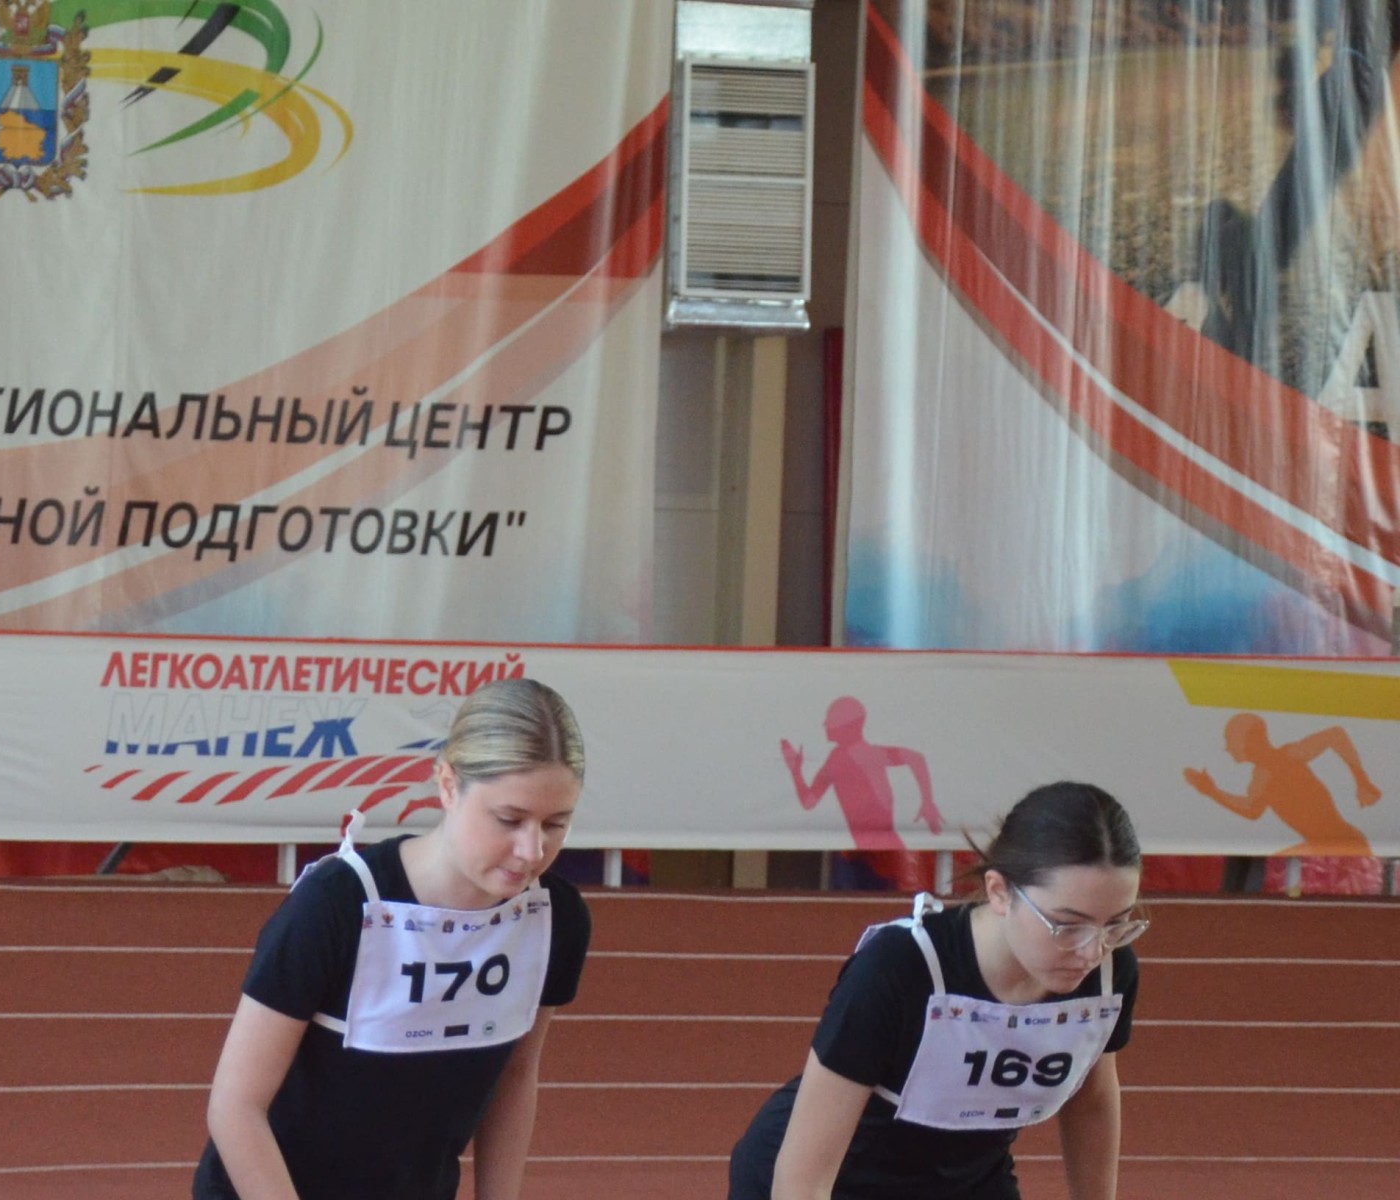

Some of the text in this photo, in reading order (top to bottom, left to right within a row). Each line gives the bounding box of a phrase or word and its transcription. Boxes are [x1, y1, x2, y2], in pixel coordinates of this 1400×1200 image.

[384, 402, 572, 458] ЦЕНТР
[115, 501, 527, 561] ПОДГОТОВКИ"
[100, 651, 526, 697] ЛЕГКОАТЛЕТИЧЕСКИЙ
[104, 692, 370, 758] МАНЕЖ
[401, 953, 510, 1003] 170
[964, 1049, 1073, 1087] 169
